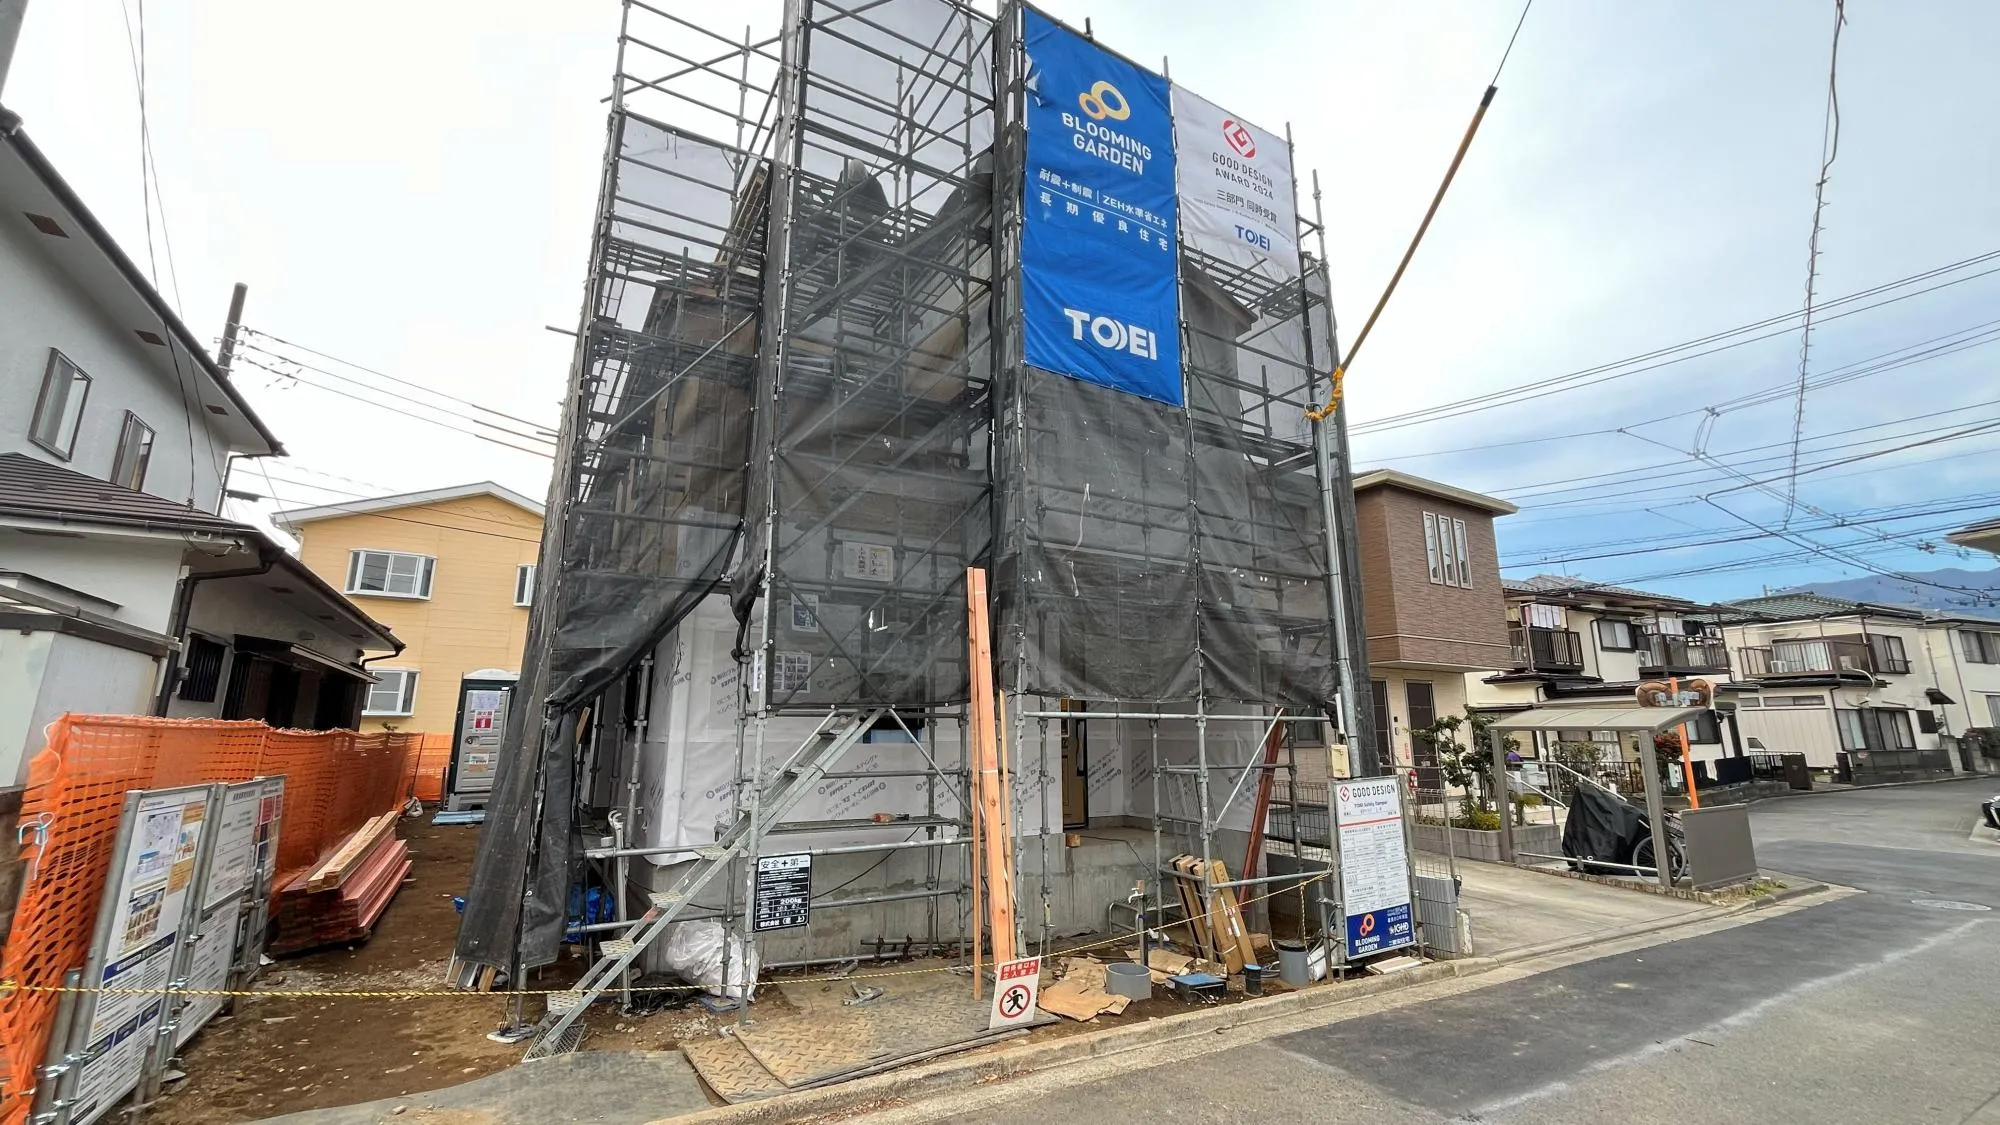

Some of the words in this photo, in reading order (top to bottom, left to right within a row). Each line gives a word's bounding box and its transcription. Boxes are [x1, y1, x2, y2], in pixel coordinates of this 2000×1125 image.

[1061, 112, 1152, 161] BLOOMING
[1073, 133, 1144, 176] GARDEN
[1212, 152, 1239, 171] GOOD
[1242, 167, 1273, 188] DESIGN
[1215, 167, 1250, 188] AWARD
[1252, 182, 1274, 201] 2024
[1216, 189, 1244, 208] 三部門
[1352, 786, 1371, 798] GOOD
[1371, 784, 1396, 796] DESIGN
[1355, 934, 1380, 947] BLOOMING
[1358, 943, 1378, 954] GARDEN
